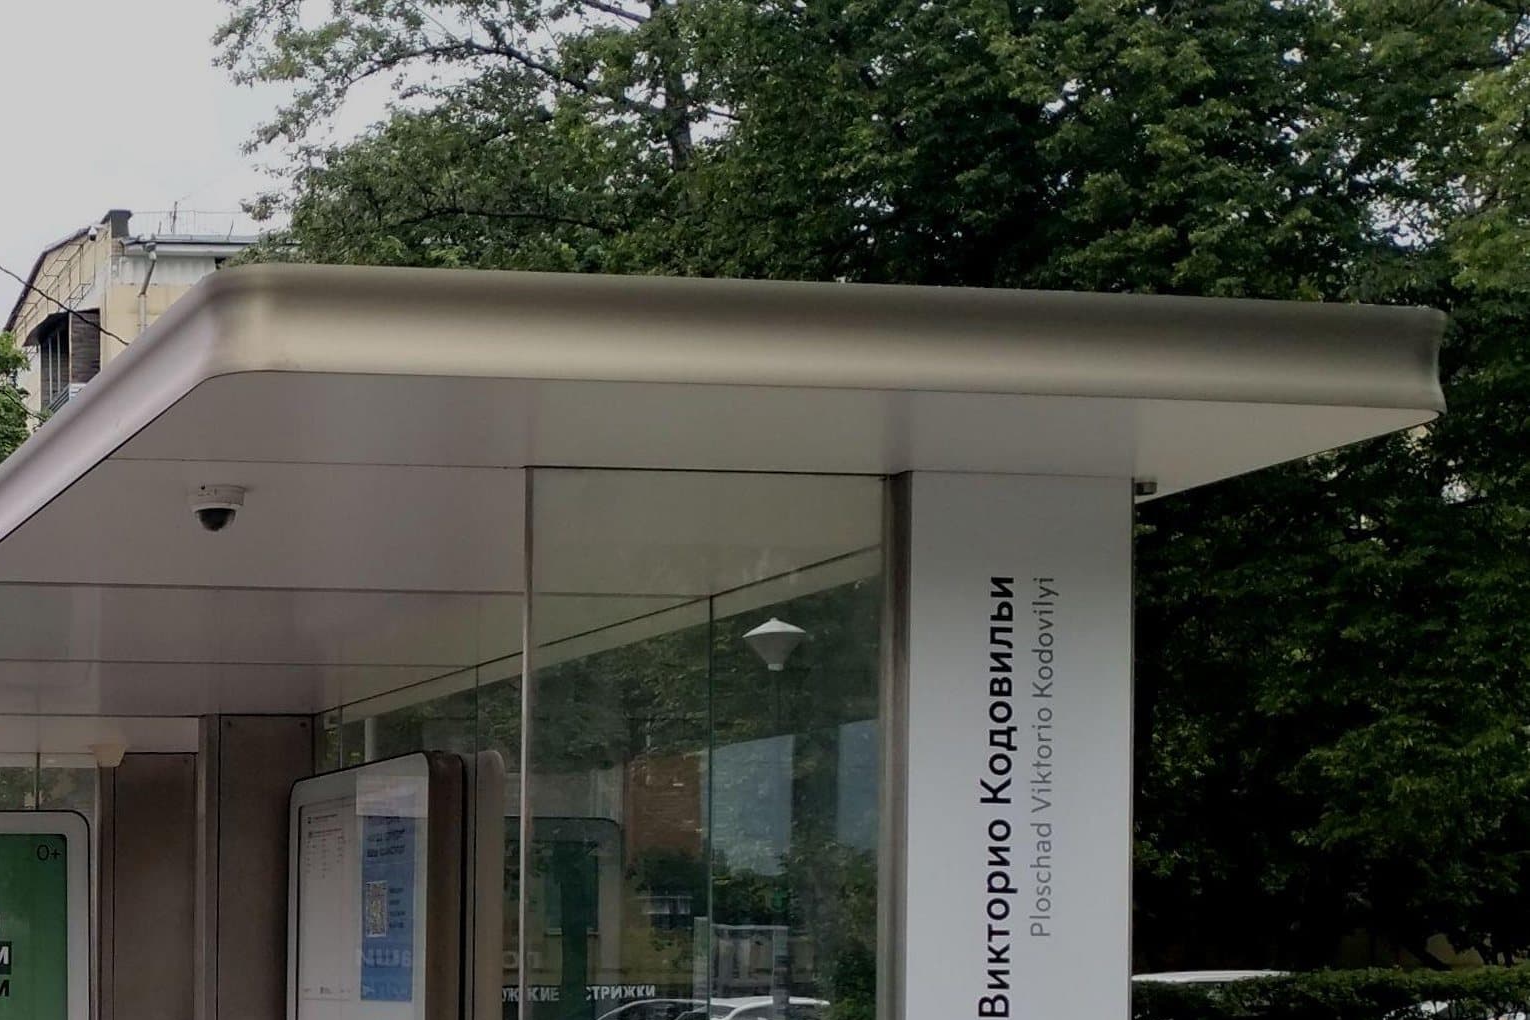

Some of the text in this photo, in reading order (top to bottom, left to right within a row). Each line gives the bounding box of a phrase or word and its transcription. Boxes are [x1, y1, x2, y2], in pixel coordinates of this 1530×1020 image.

[980, 576, 1017, 805] Кодовильи
[1030, 577, 1060, 937] Ploschad Viktorio Kodovilyi
[36, 844, 61, 861] 0+
[978, 818, 1018, 1019] Викторио
